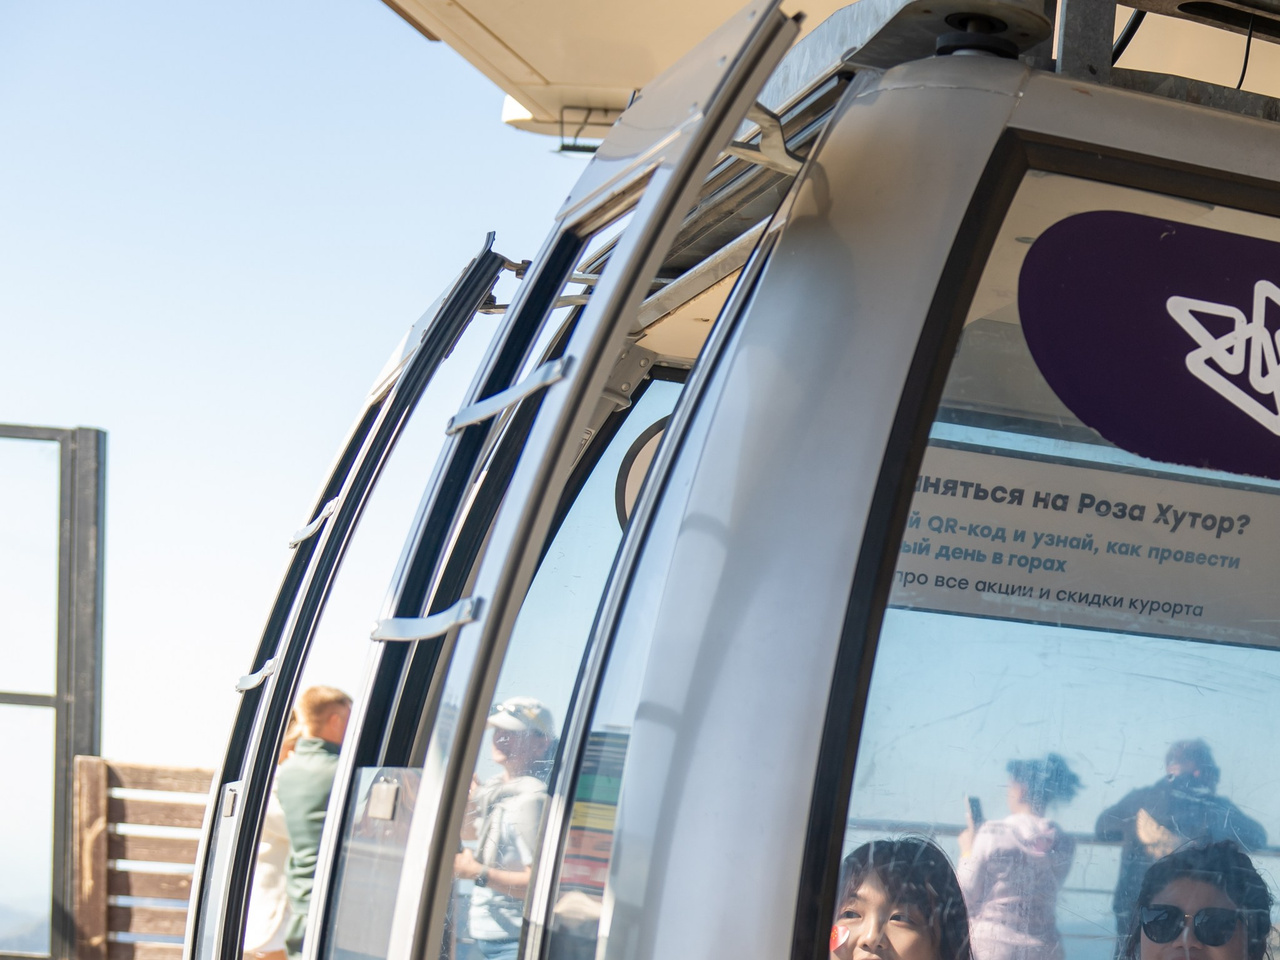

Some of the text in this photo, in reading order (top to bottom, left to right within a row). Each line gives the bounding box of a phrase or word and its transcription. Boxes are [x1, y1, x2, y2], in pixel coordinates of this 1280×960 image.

[1032, 491, 1070, 512] на
[1077, 492, 1146, 522] Роза
[1153, 503, 1251, 539] Хутор?
[928, 515, 1006, 543] QR-код
[1013, 529, 1026, 543] и
[1032, 531, 1099, 556] узнай,
[1106, 541, 1143, 557] как
[1148, 546, 1241, 570] провести
[935, 545, 987, 563] день
[991, 552, 1003, 565] в
[1008, 553, 1067, 573] горах
[934, 575, 969, 590] все
[975, 580, 1034, 598] акции
[1039, 587, 1051, 600] и
[1056, 589, 1124, 608] скидки
[1129, 598, 1204, 618] курорта
